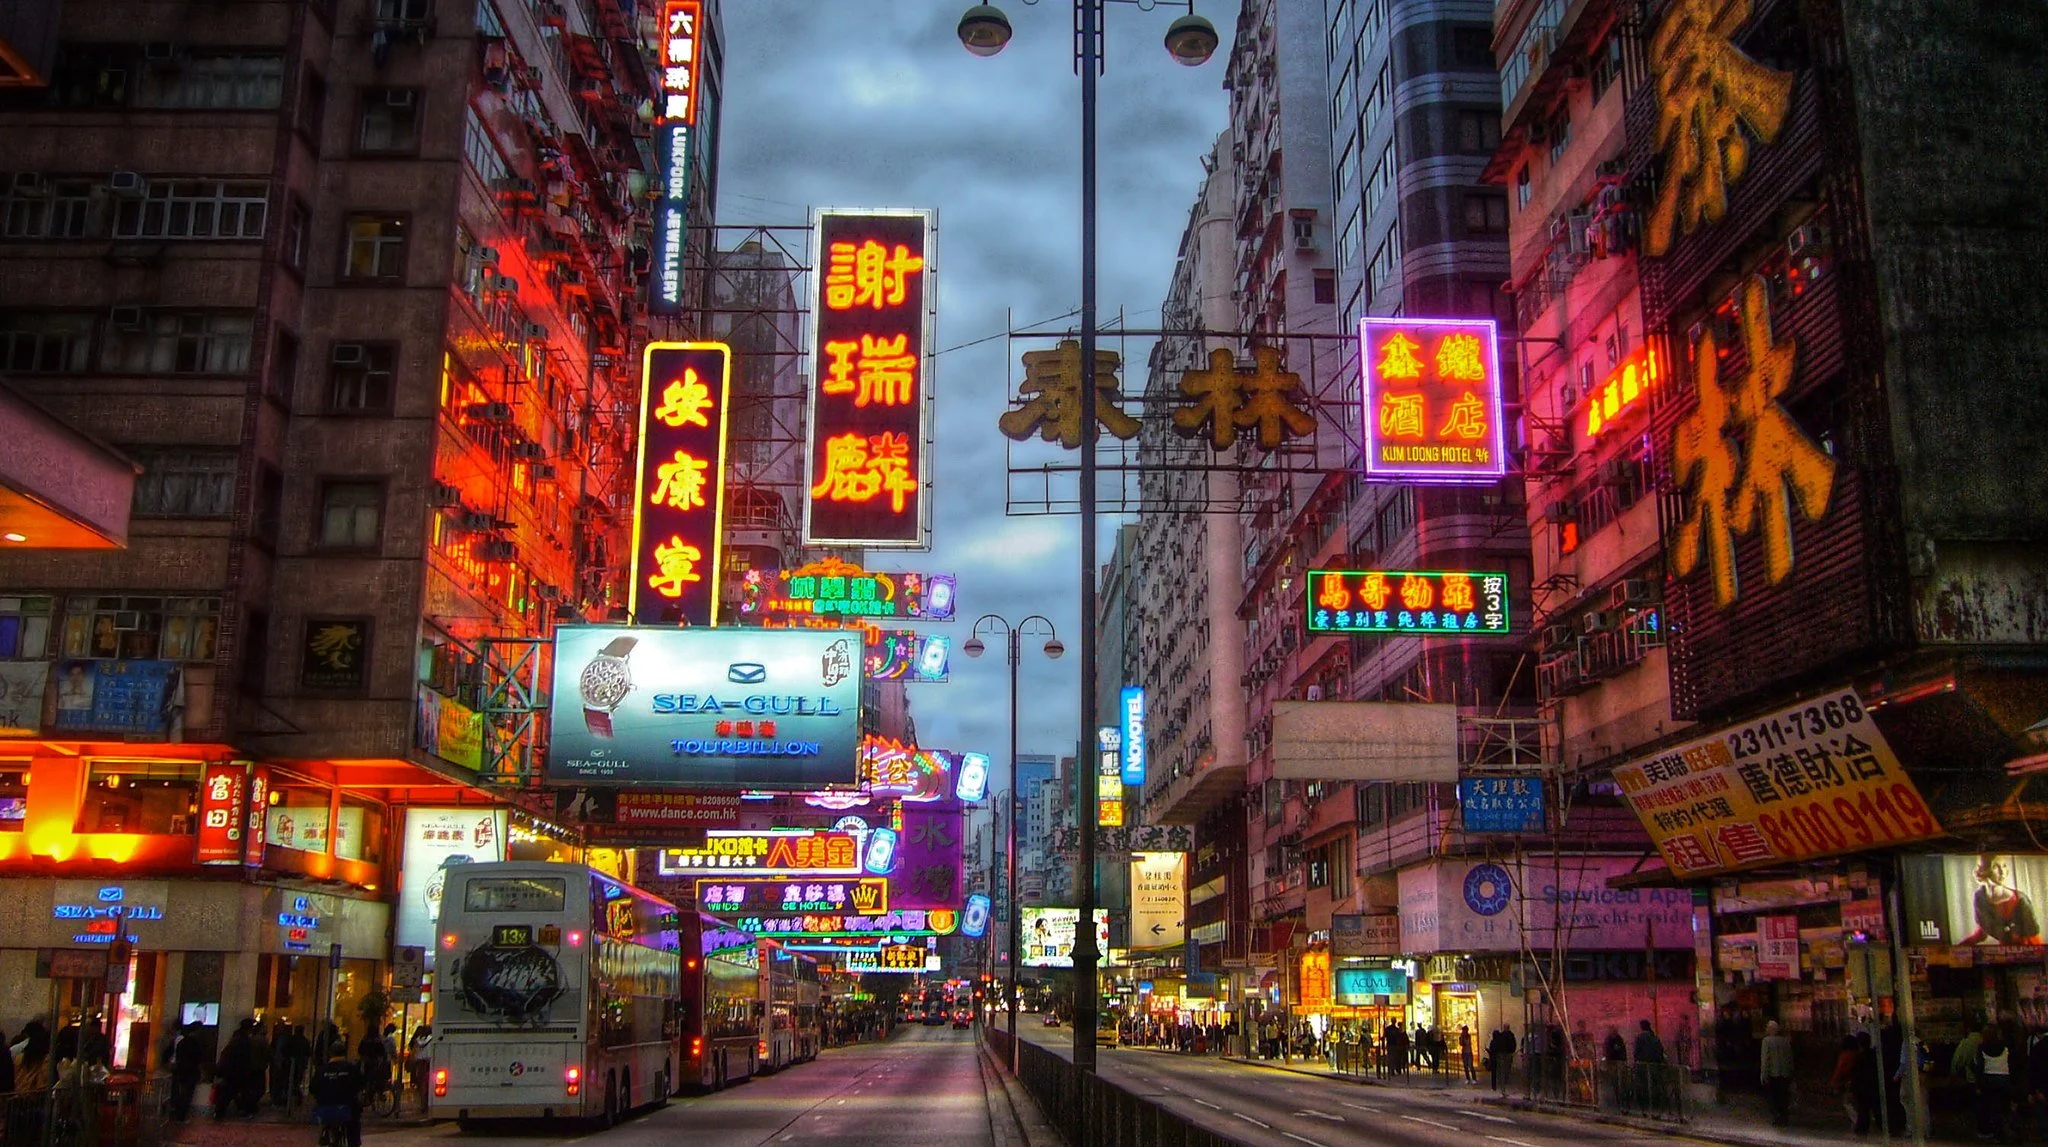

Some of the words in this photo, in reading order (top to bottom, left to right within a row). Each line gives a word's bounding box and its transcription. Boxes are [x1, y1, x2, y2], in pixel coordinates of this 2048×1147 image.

[669, 127, 687, 200] LUKFOOK
[663, 209, 681, 303] JEWELLERY
[812, 239, 924, 515] 謝瑞麟
[999, 339, 1317, 452] 泰林
[1381, 391, 1487, 438] 酒店
[1382, 446, 1404, 462] KUM
[1407, 446, 1439, 462] LOONG
[1442, 447, 1472, 463] HOTEL
[649, 367, 714, 598] 安康寧
[652, 693, 840, 716] SEA-GULL
[1728, 693, 1864, 760] 2311-7368
[670, 738, 820, 757] TOURBILLON
[1126, 691, 1143, 773] NOVOTEL
[566, 760, 630, 769] SEA-GULL
[206, 774, 232, 828] 富田
[630, 806, 737, 820] www.dance.com.hk
[1759, 801, 1847, 858] 8100
[1833, 783, 1934, 842] 9119
[1661, 822, 1776, 873] 租/售
[799, 902, 834, 911] HOTEL
[1542, 882, 1640, 905] Serviced
